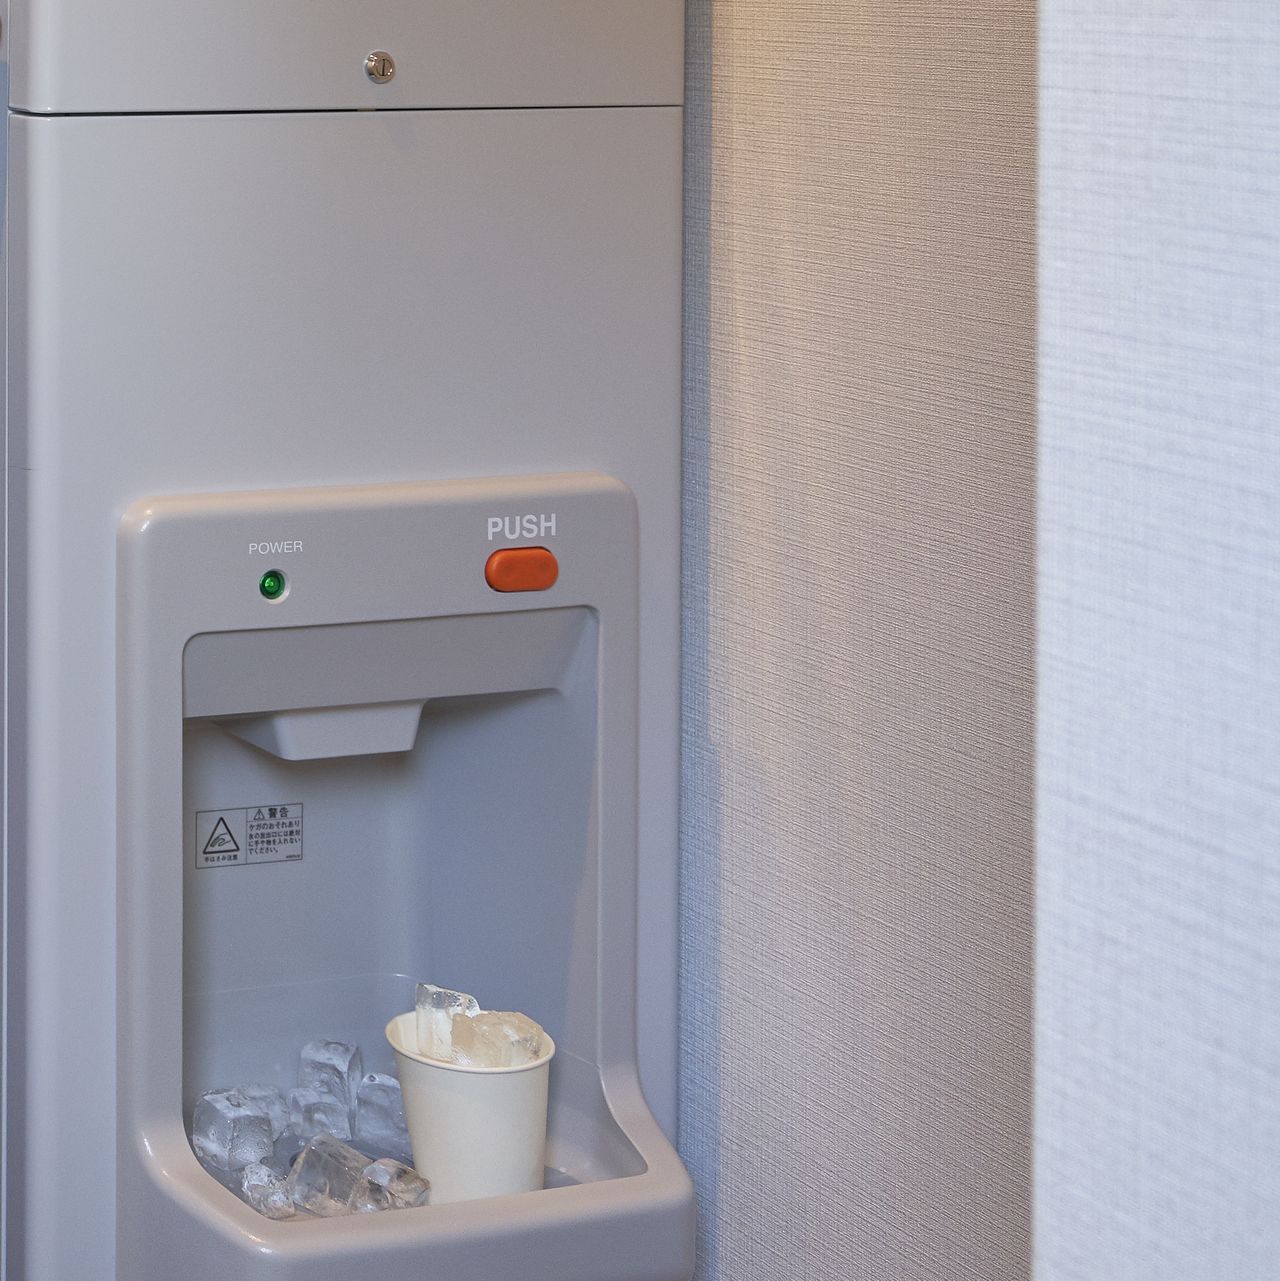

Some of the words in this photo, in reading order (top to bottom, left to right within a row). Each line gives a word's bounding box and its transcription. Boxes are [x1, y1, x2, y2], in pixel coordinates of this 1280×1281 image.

[487, 513, 558, 540] PUSH
[248, 540, 304, 555] POWER
[268, 806, 289, 819] 警告
